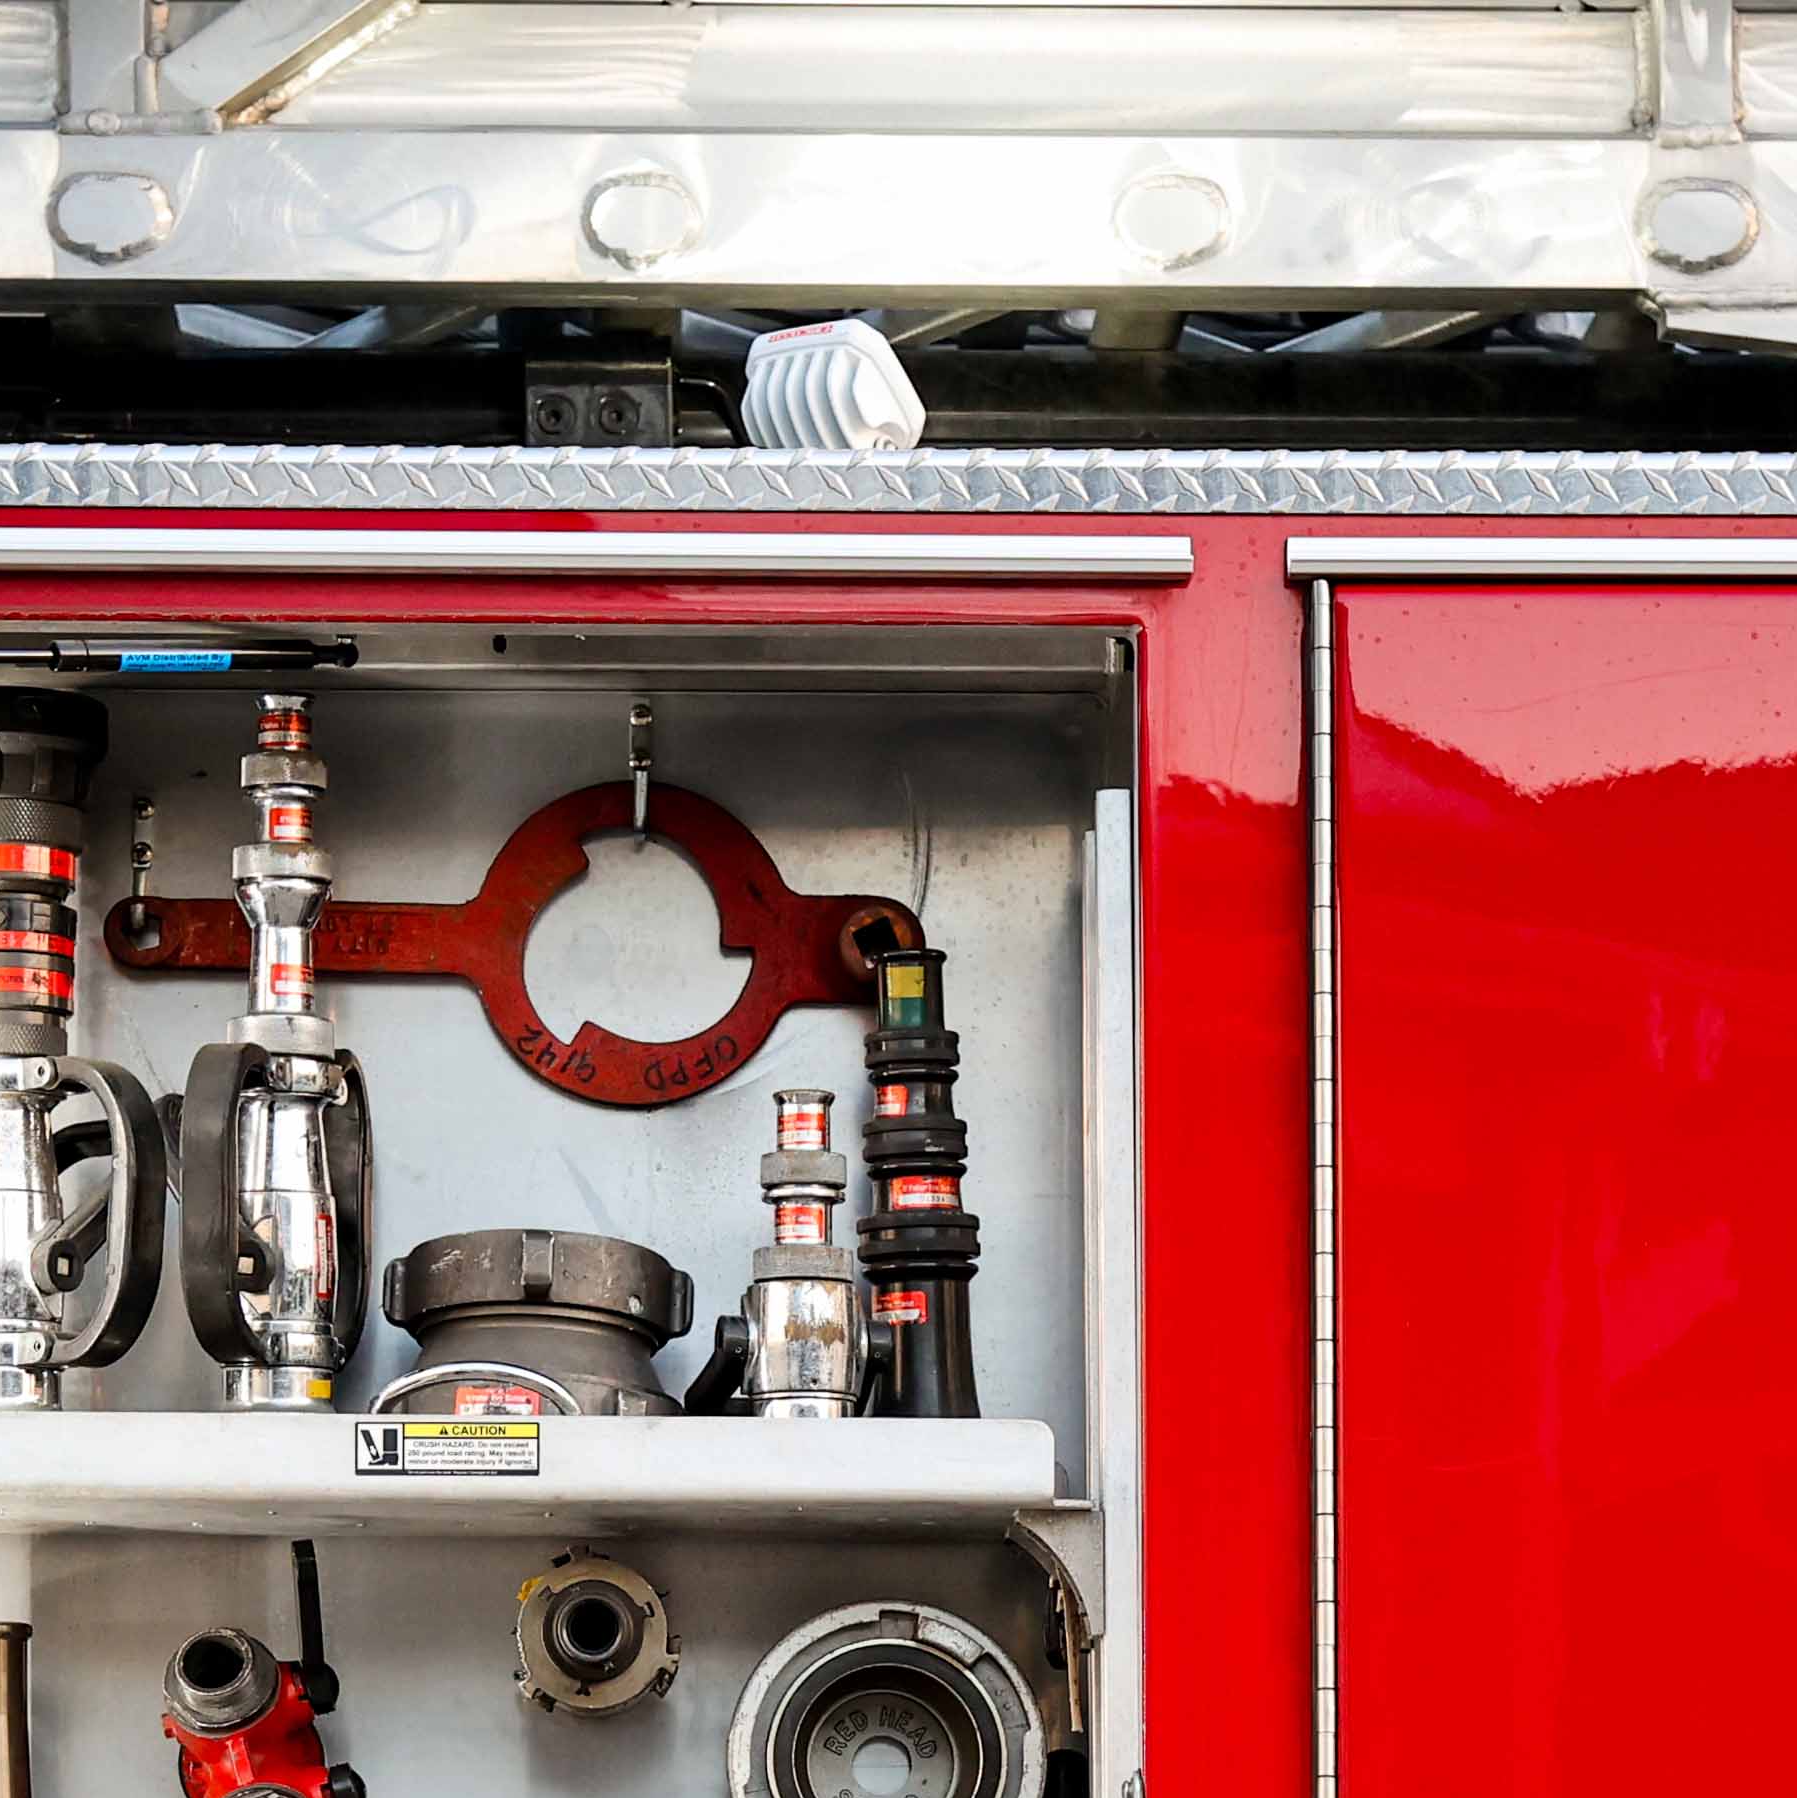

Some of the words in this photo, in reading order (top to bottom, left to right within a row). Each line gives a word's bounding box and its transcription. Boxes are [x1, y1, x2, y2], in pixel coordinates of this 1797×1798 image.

[515, 1025, 596, 1083] 9142
[452, 1427, 506, 1435] CAUTION
[824, 1711, 868, 1756] RED
[879, 1707, 937, 1758] HEAD
